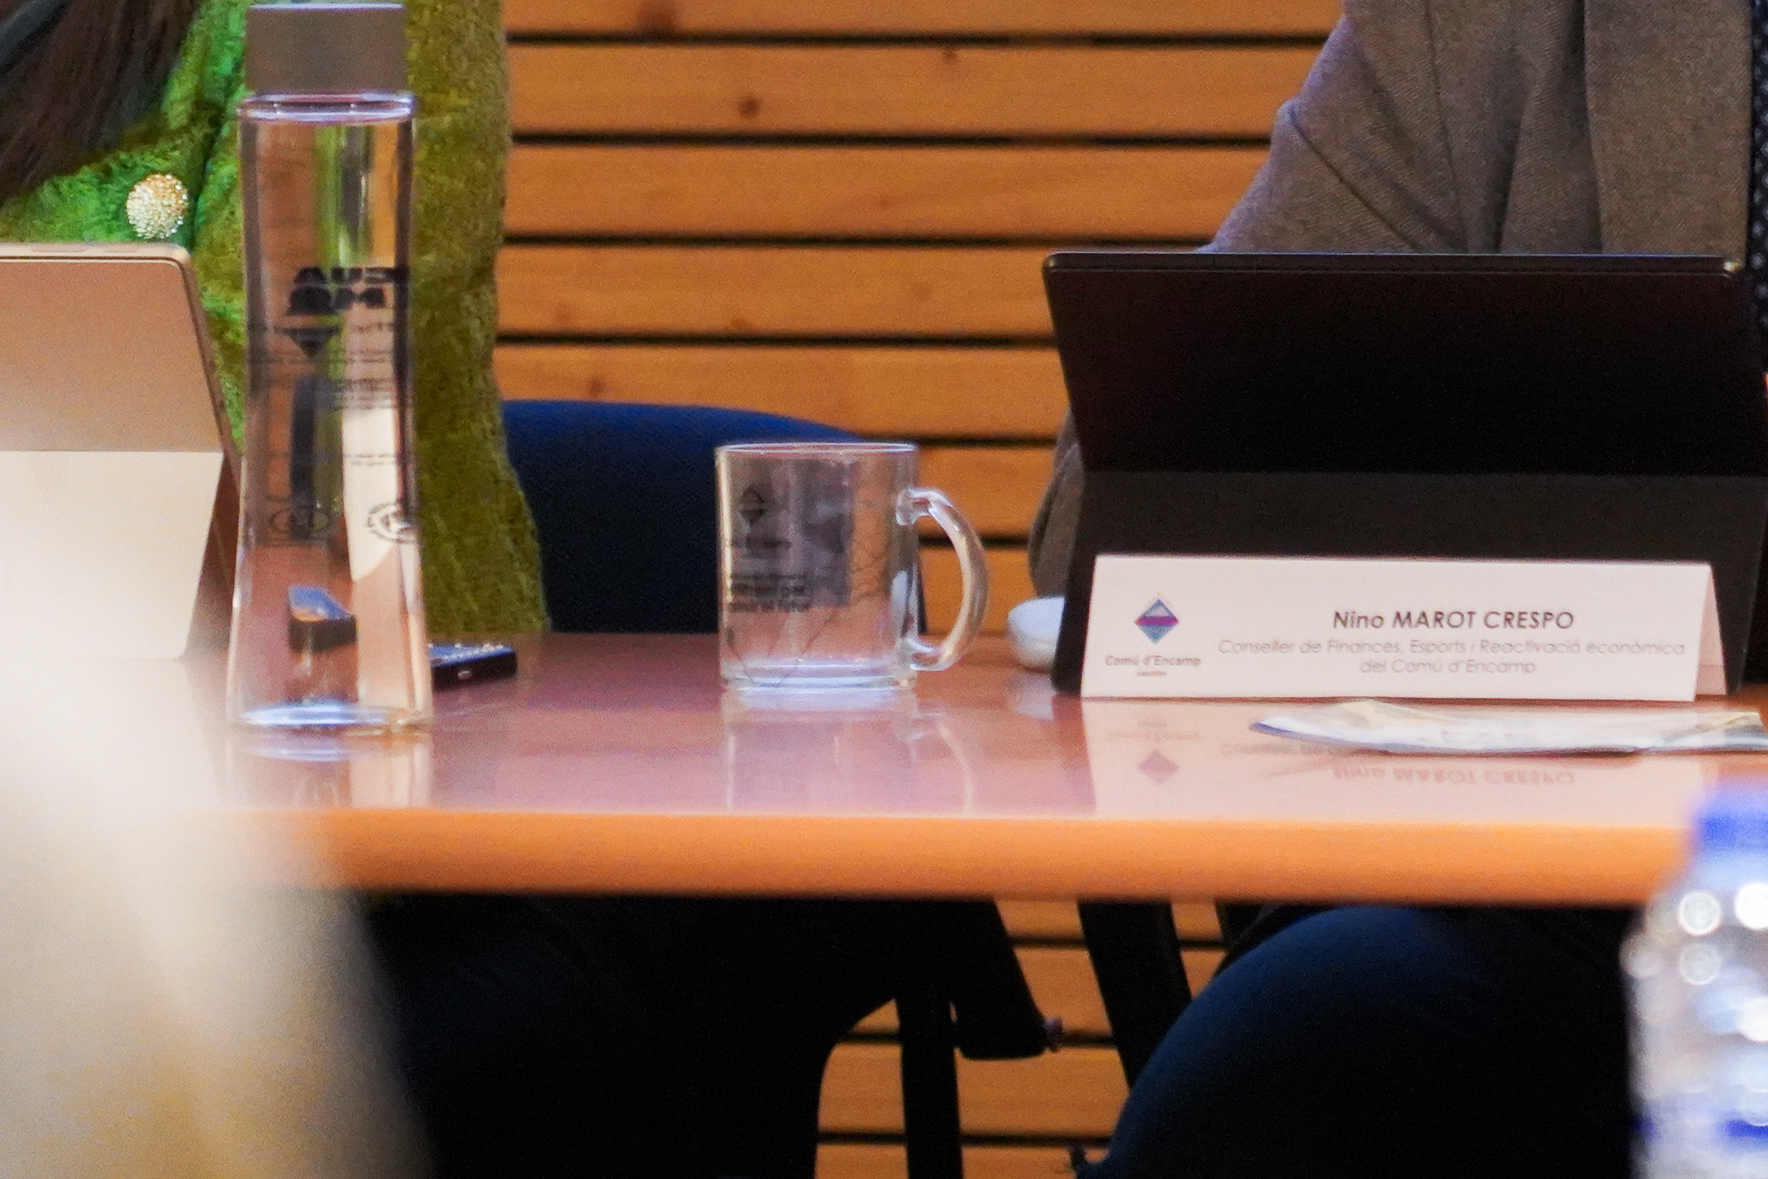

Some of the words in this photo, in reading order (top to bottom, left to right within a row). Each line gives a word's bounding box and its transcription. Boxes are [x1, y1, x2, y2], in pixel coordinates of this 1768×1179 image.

[1333, 611, 1384, 629] Nino
[1392, 611, 1476, 630] MAROT
[1483, 611, 1575, 630] CRESPO
[1218, 639, 1295, 654] Conseller
[1299, 640, 1323, 654] de
[1411, 639, 1465, 657] Esports
[1480, 638, 1580, 655] Reactivació
[1586, 638, 1686, 656] econòmica
[1360, 659, 1386, 674] del
[1391, 658, 1443, 674] Comú
